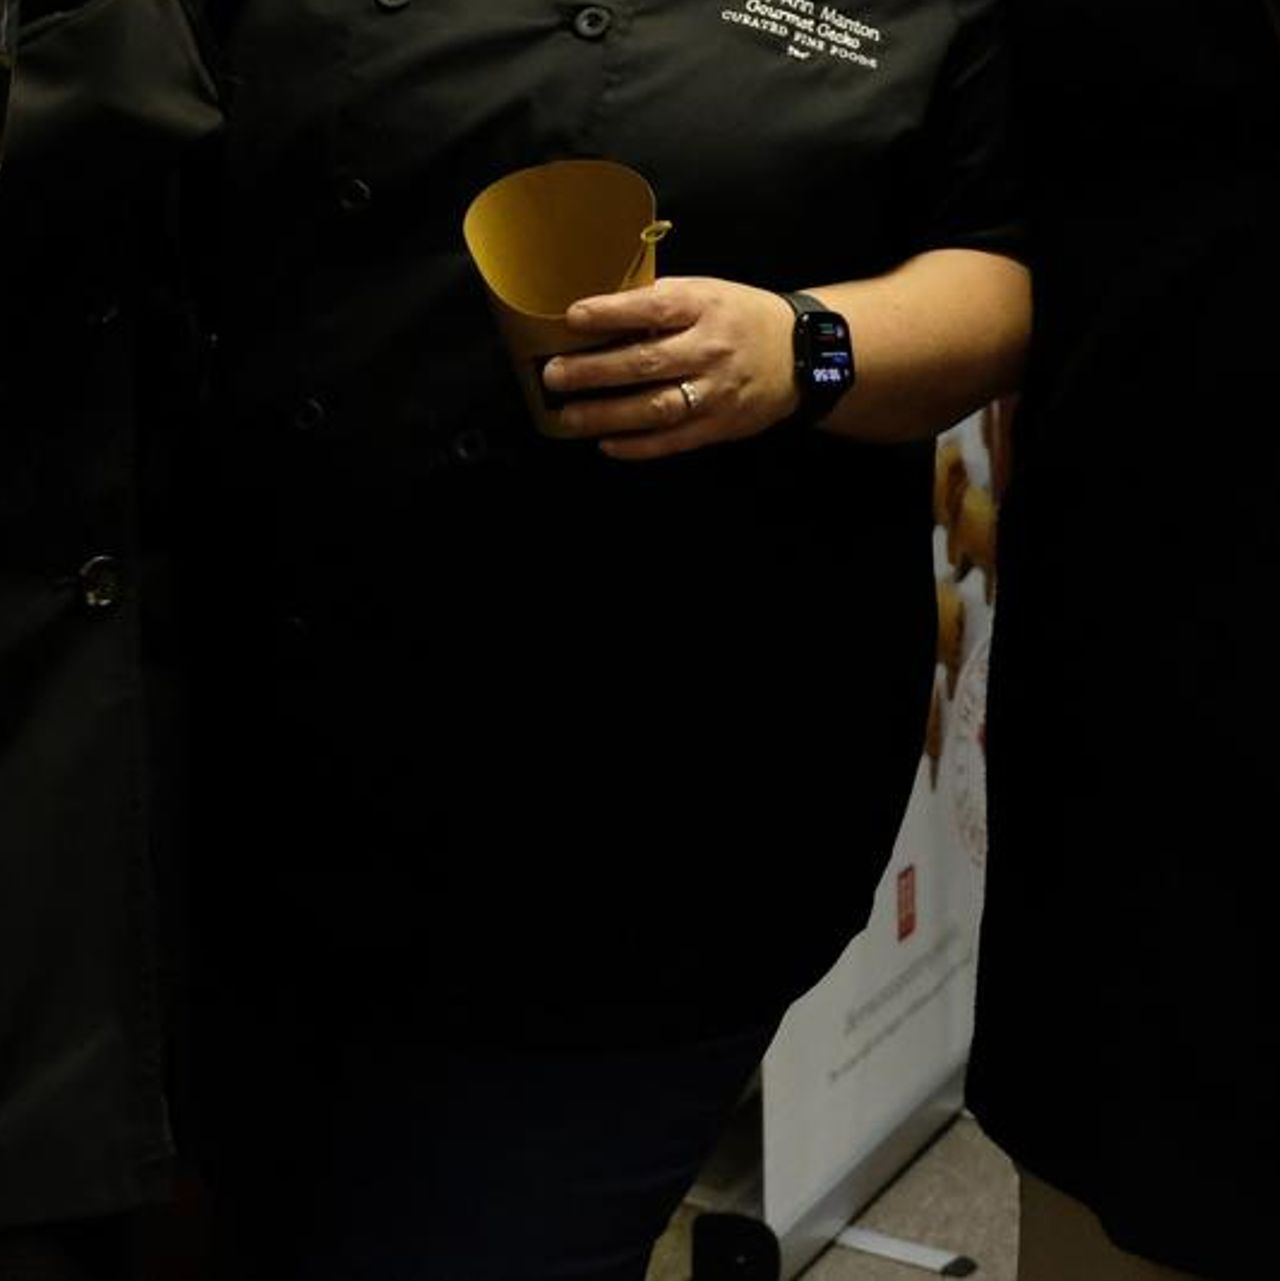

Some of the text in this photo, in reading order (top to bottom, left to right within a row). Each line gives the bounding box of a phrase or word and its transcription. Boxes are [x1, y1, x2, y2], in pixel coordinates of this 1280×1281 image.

[721, 10, 789, 37] CURATED
[830, 45, 878, 68] FOODS
[745, 0, 861, 49] Gourmet Gecko
